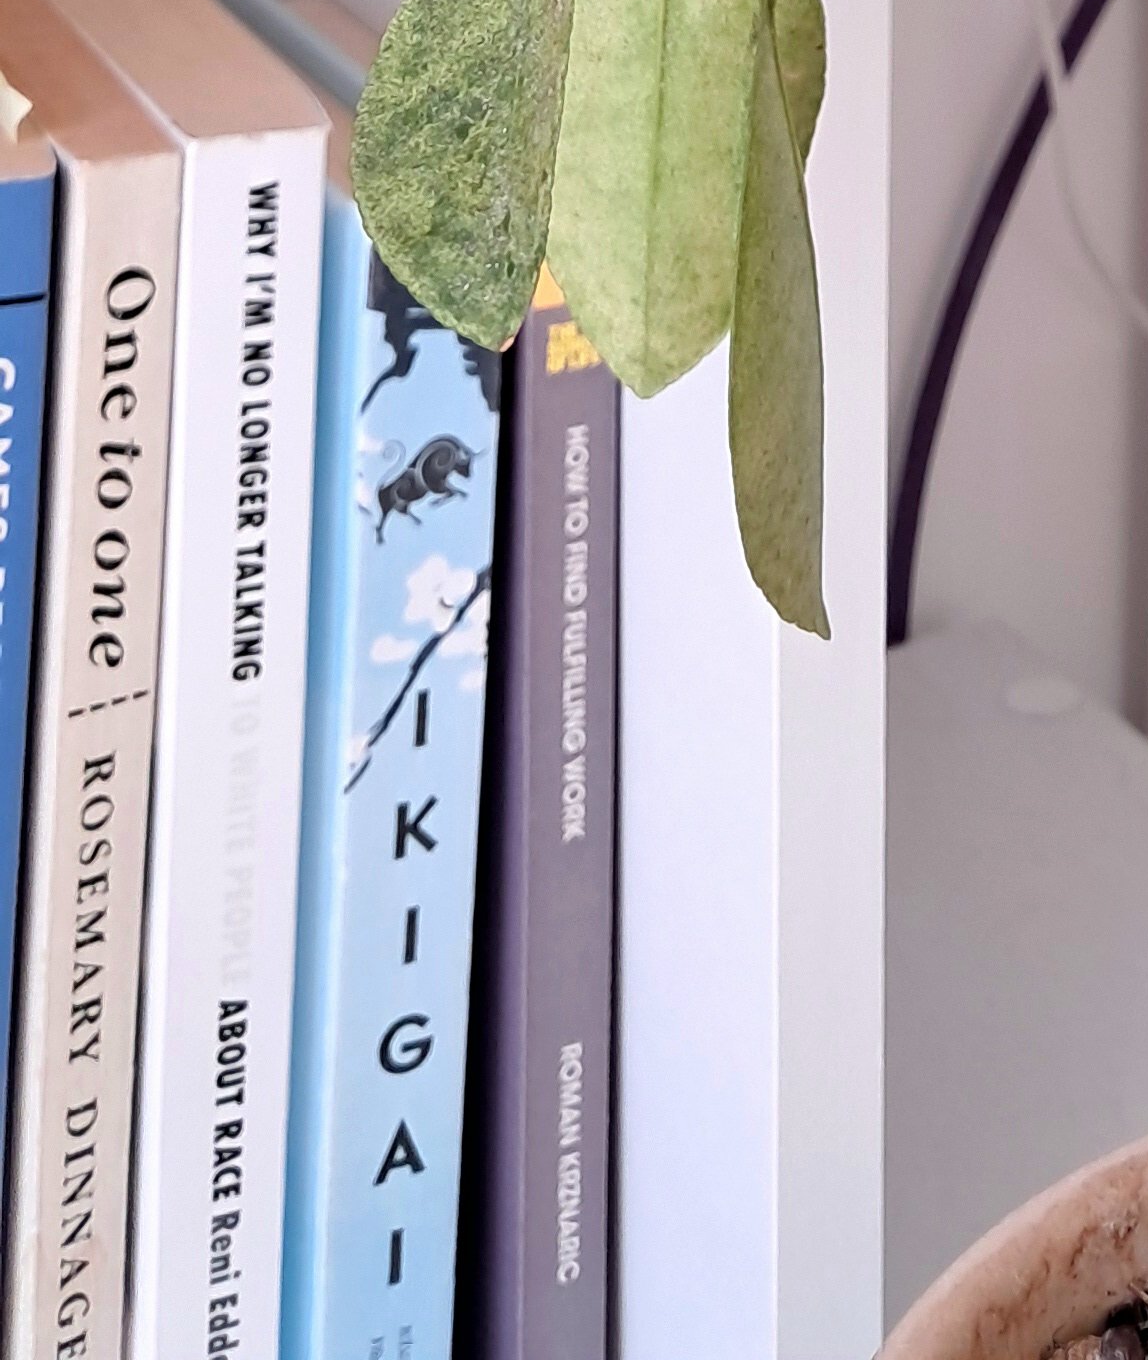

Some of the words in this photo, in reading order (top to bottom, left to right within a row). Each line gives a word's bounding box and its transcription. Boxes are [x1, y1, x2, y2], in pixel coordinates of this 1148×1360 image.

[245, 180, 280, 270] WHY
[100, 264, 156, 420] One
[243, 273, 279, 327] I'M
[242, 341, 273, 387] NO
[98, 438, 142, 510] to
[237, 399, 272, 532] LONGER
[564, 424, 590, 493] HOW
[563, 498, 588, 537] TO
[89, 530, 131, 669] one
[230, 541, 267, 682] TALKING
[562, 542, 588, 603] FIND
[560, 611, 587, 750] FULFILLING
[559, 756, 585, 841] WORK
[68, 752, 117, 1064] ROSEMARY
[214, 1000, 249, 1106] ABOUT
[557, 1042, 583, 1144] ROMAN
[210, 1121, 245, 1201] RACE
[56, 1098, 98, 1360] DINNAGE
[209, 1212, 241, 1285] Reni
[555, 1151, 581, 1284] KRZNARIC
